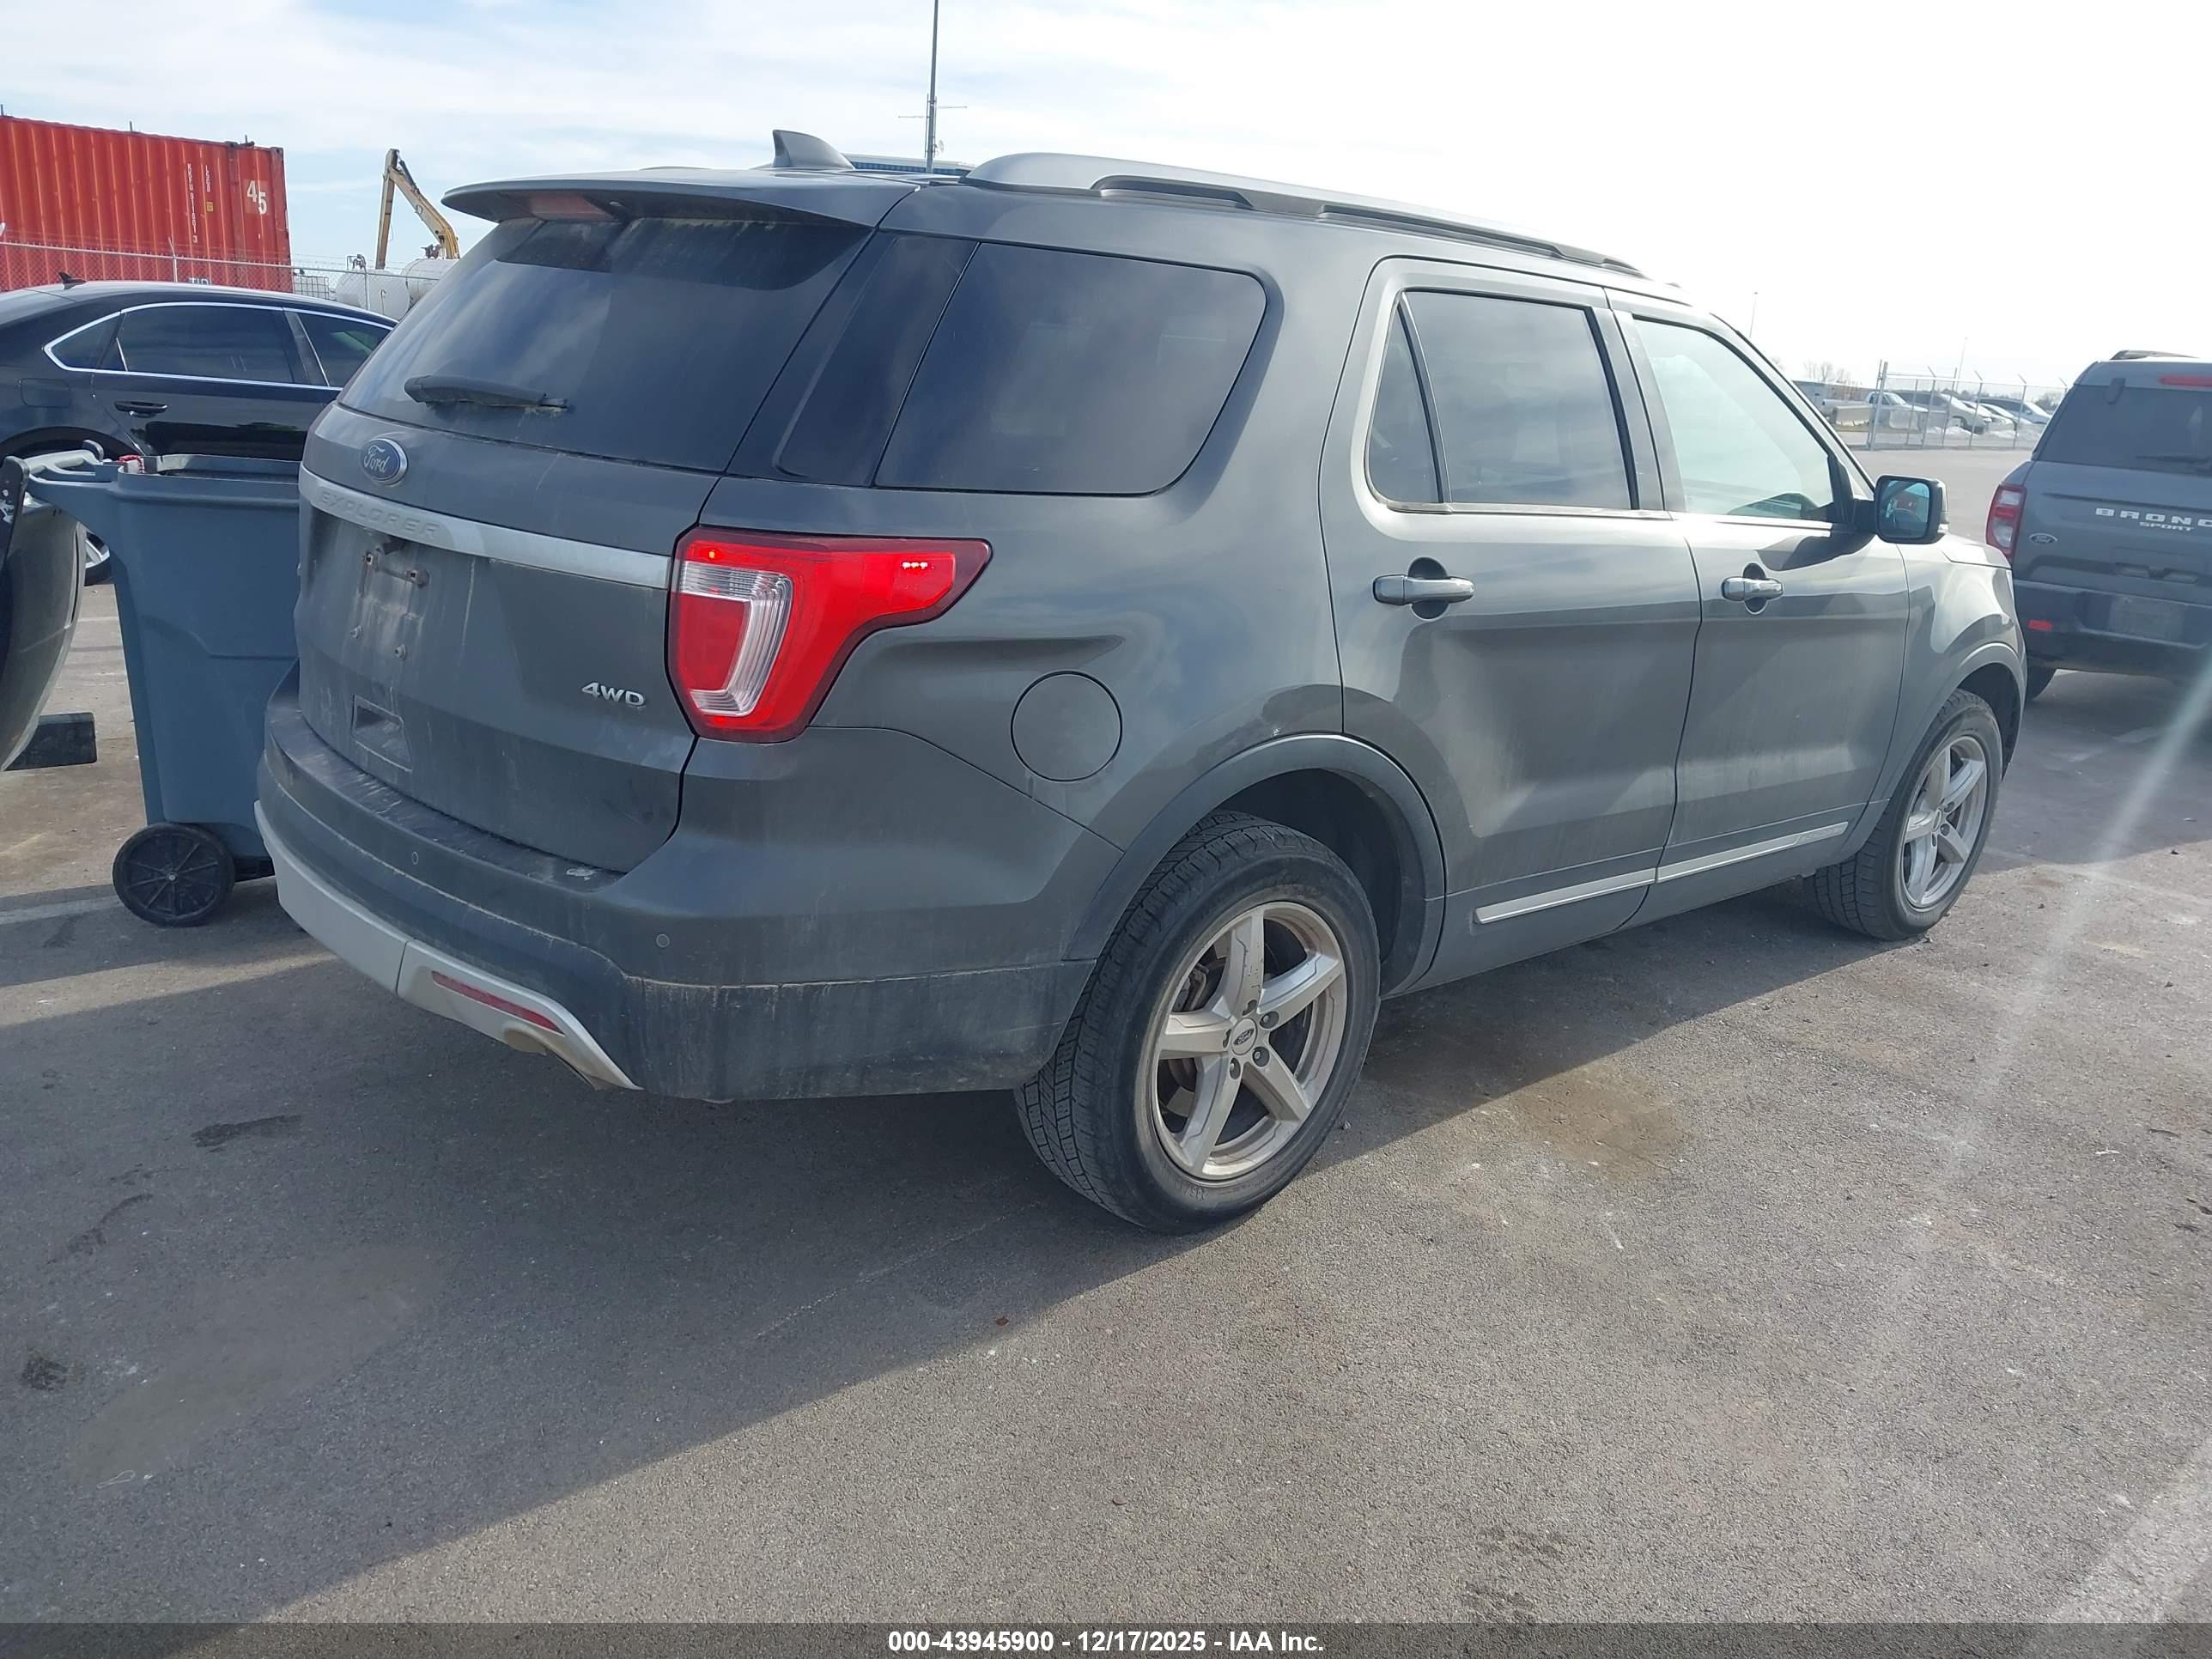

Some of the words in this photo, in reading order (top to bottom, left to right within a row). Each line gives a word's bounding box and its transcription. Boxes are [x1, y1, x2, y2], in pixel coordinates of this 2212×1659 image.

[246, 179, 267, 215] 45
[364, 445, 390, 473] Ford
[320, 490, 441, 538] EXPLORER
[2140, 521, 2194, 532] SPORT
[581, 682, 644, 706] 4WD
